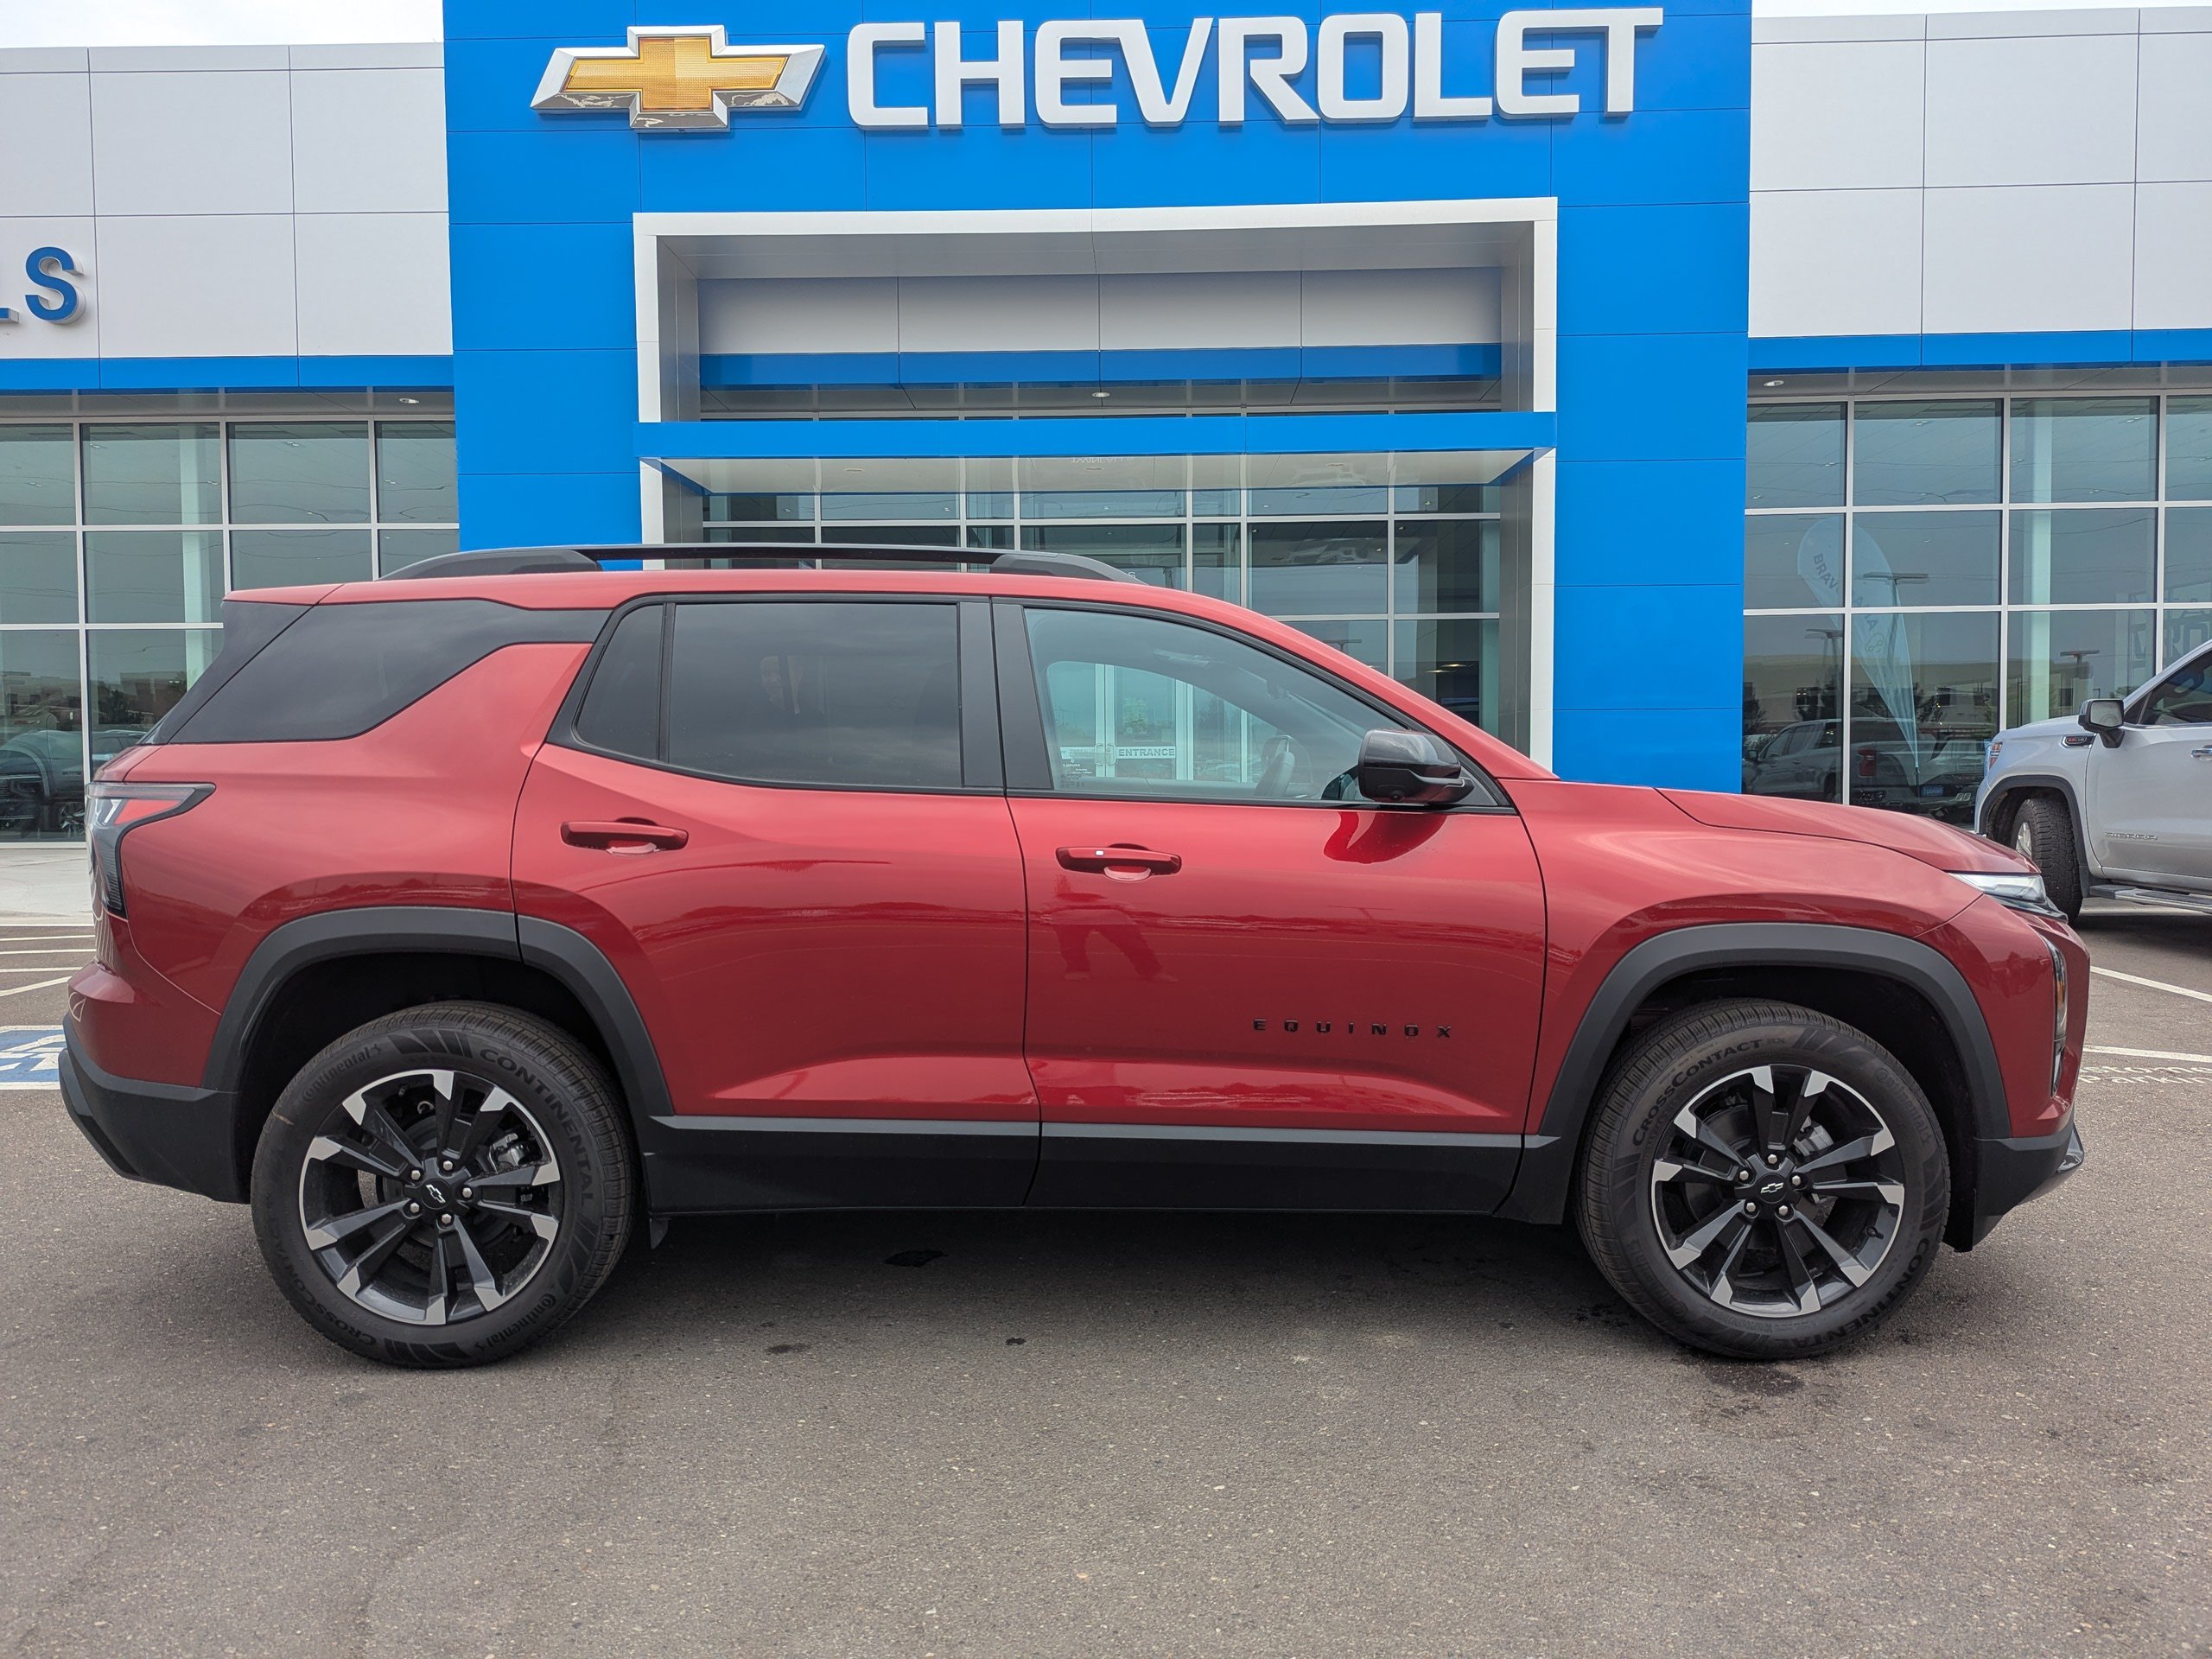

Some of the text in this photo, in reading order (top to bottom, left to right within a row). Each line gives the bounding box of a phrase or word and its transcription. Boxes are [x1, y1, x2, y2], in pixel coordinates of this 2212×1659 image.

[847, 8, 1664, 130] CHEVROLET
[0, 246, 86, 325] S
[1118, 748, 1175, 757] ENTRANCE
[1253, 1018, 1452, 1039] EQUINOX
[480, 1048, 594, 1206] CONTINENTAL
[486, 1293, 557, 1348] Continental
